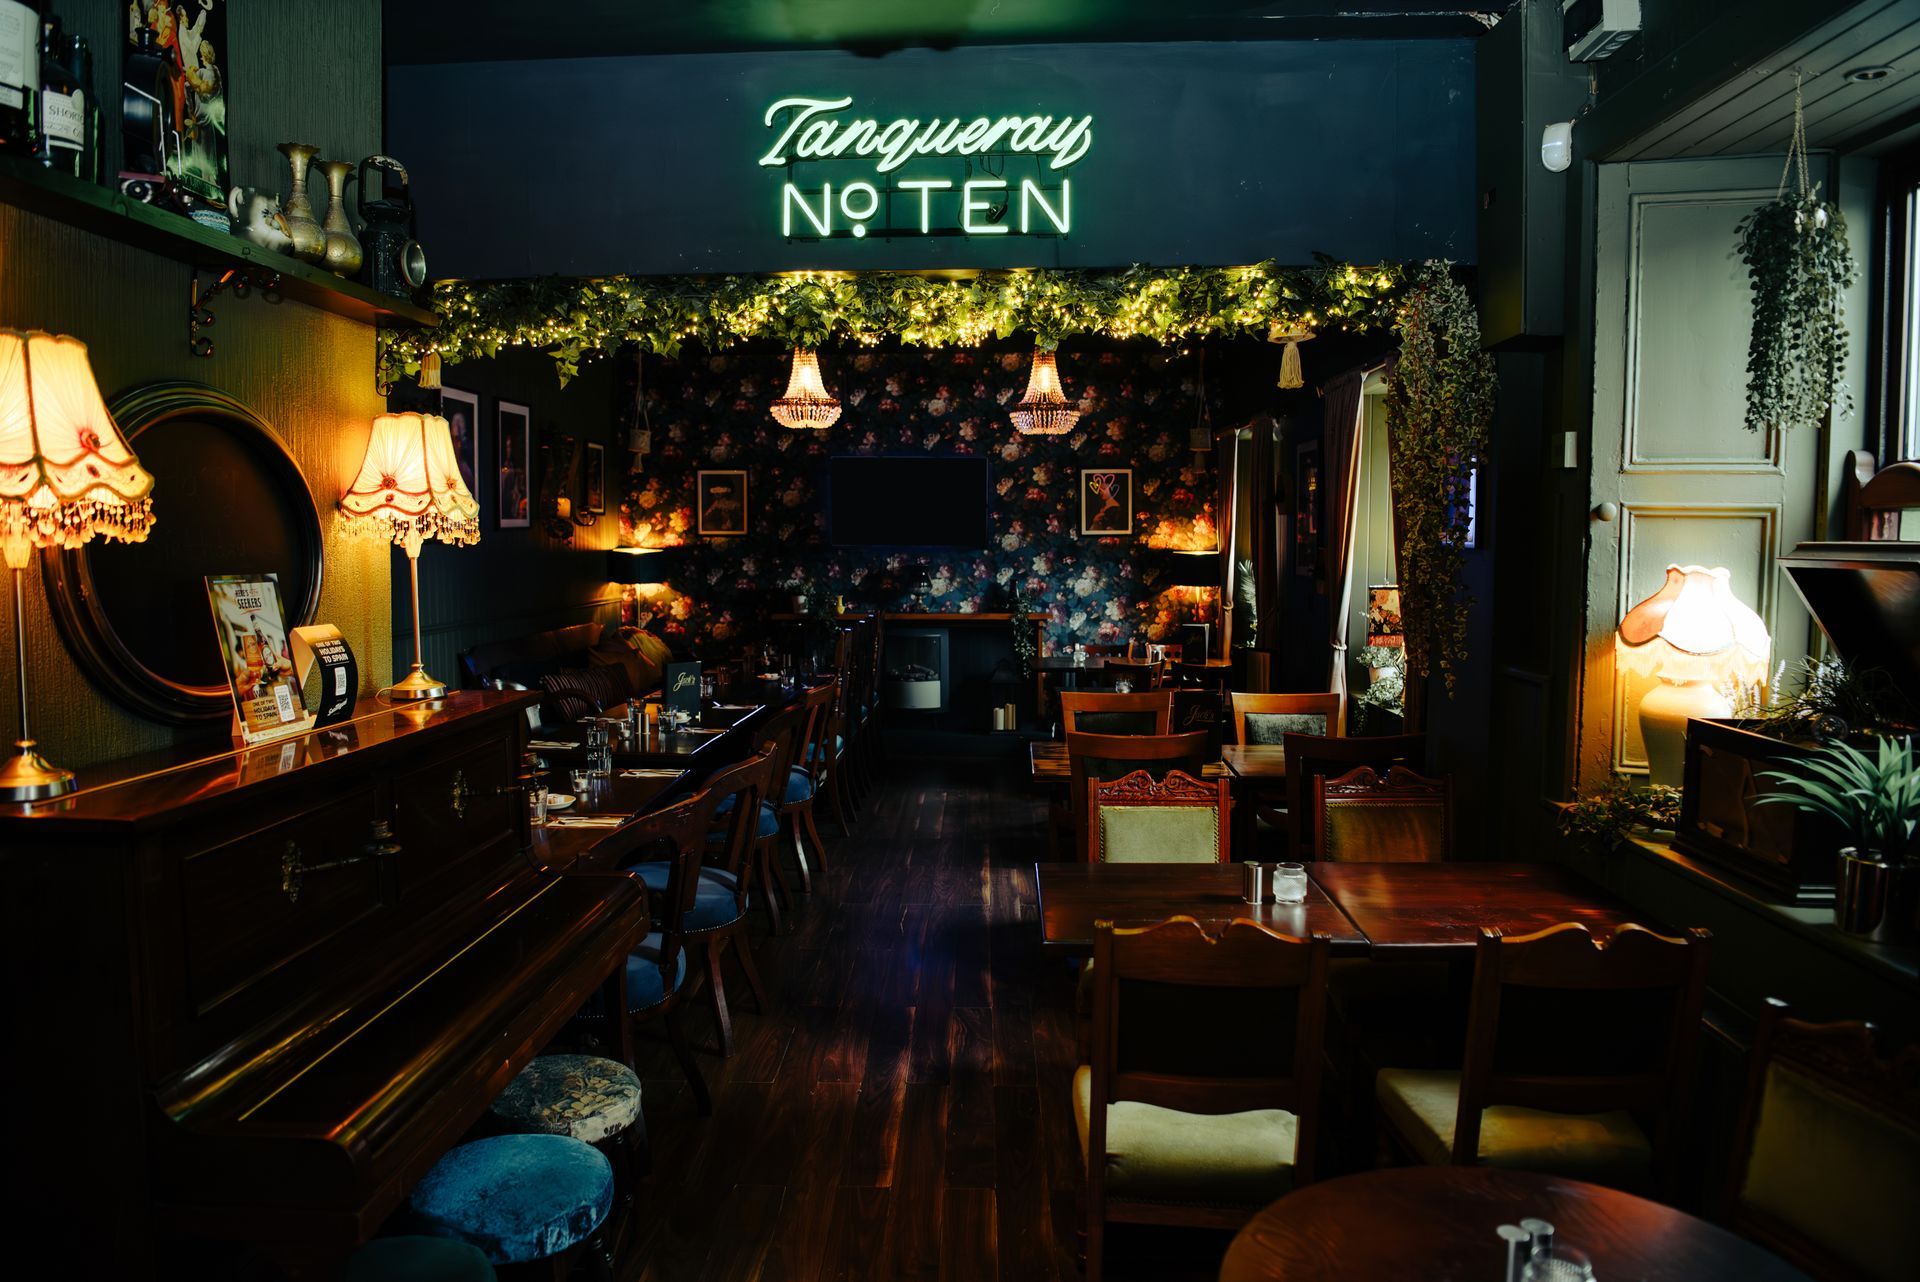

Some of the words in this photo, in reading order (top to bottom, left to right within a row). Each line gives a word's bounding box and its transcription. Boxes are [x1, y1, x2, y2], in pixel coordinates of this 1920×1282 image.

[759, 96, 1093, 173] Tanqueray
[897, 178, 1070, 234] TEN
[237, 597, 262, 609] SEEKERS
[318, 645, 346, 655] HOLIDAYS
[322, 655, 332, 664] TO
[331, 653, 349, 662] SPAIN
[263, 711, 278, 720] SPAIN
